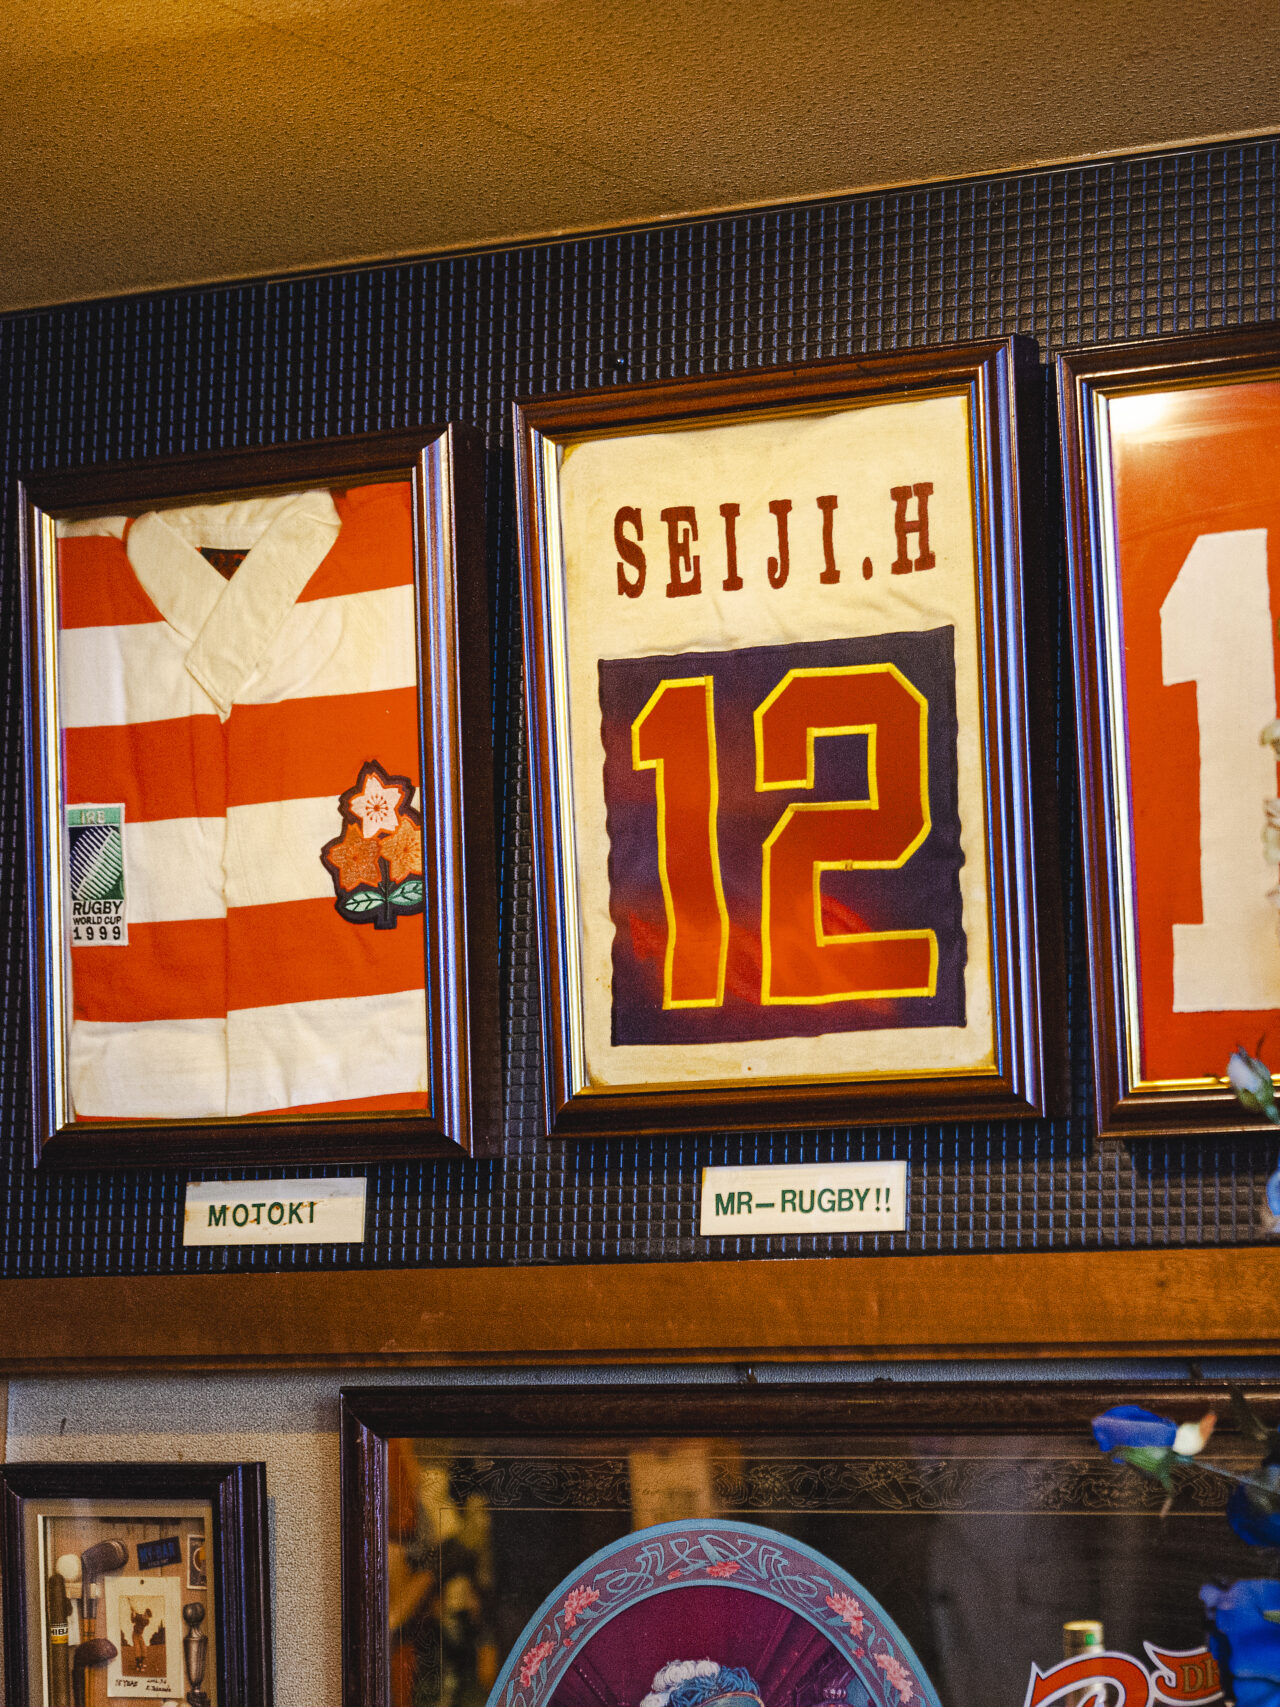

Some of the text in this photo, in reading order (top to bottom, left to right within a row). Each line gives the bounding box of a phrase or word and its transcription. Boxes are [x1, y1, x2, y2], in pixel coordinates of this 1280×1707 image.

[631, 662, 939, 1010] 12
[72, 900, 123, 916] RUGBY
[72, 915, 122, 926] WORLD CUP
[73, 926, 121, 941] 1999
[207, 1201, 315, 1227] MOTOKI
